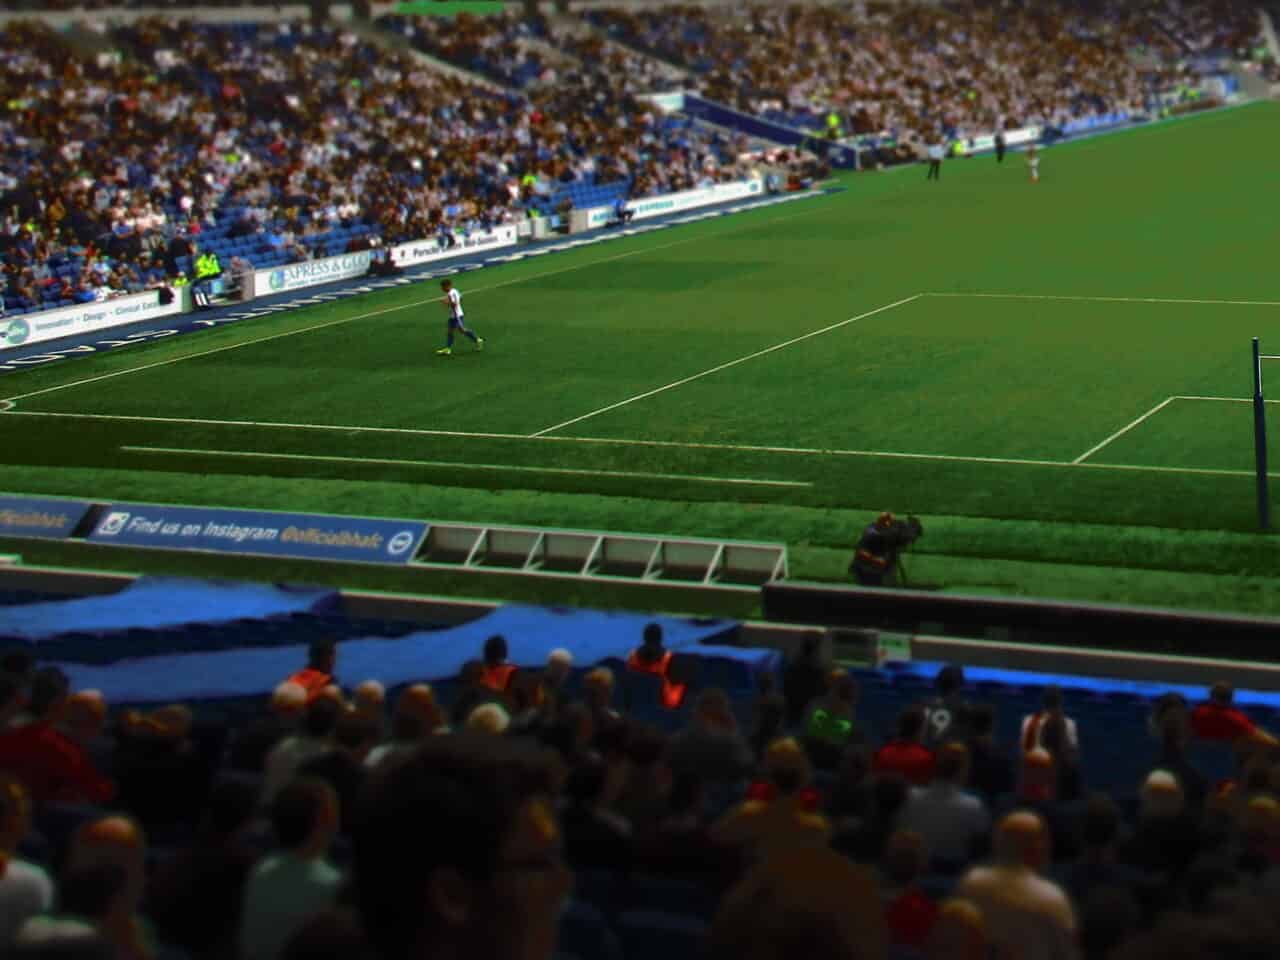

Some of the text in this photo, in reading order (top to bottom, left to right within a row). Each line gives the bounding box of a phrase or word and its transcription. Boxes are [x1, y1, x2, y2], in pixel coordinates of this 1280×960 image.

[127, 516, 162, 533] Find
[160, 523, 178, 535] us
[182, 524, 200, 537] on
[203, 520, 279, 543] Instagram
